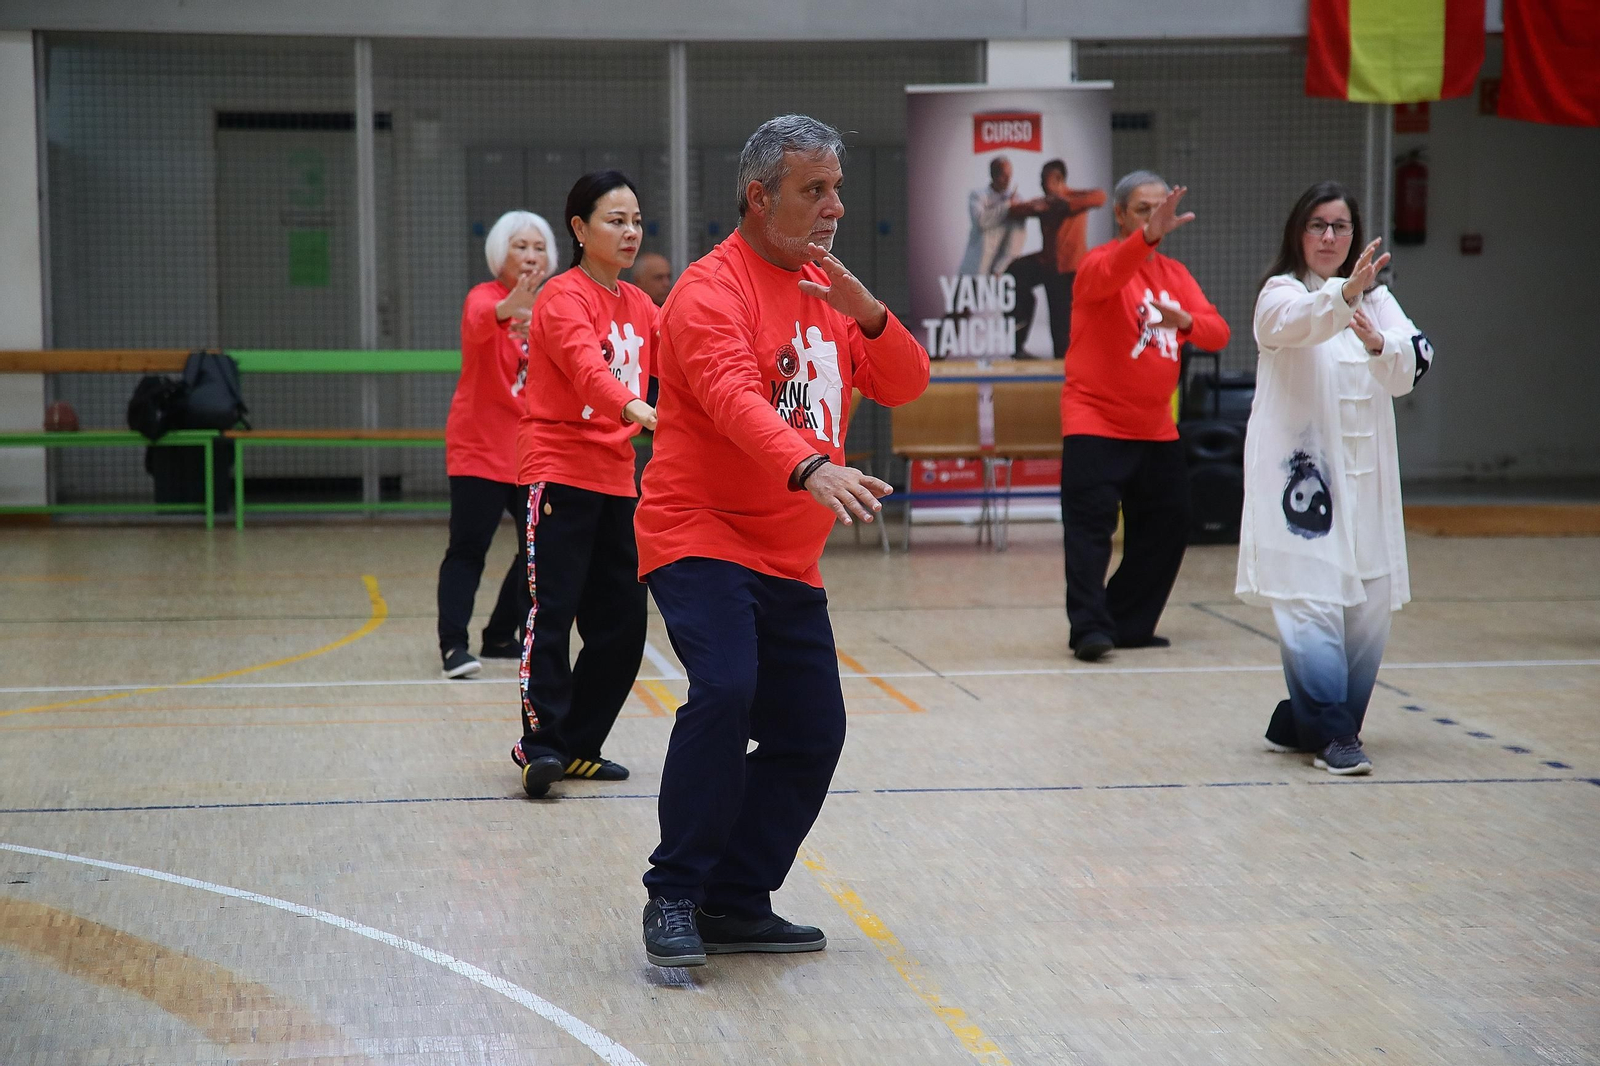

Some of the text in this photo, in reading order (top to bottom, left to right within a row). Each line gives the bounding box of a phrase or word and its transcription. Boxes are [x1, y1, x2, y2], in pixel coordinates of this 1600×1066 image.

[982, 120, 1032, 143] CURSO
[939, 273, 1016, 315] YANG
[922, 317, 1016, 358] TAICHI
[775, 408, 819, 429] AICHI
